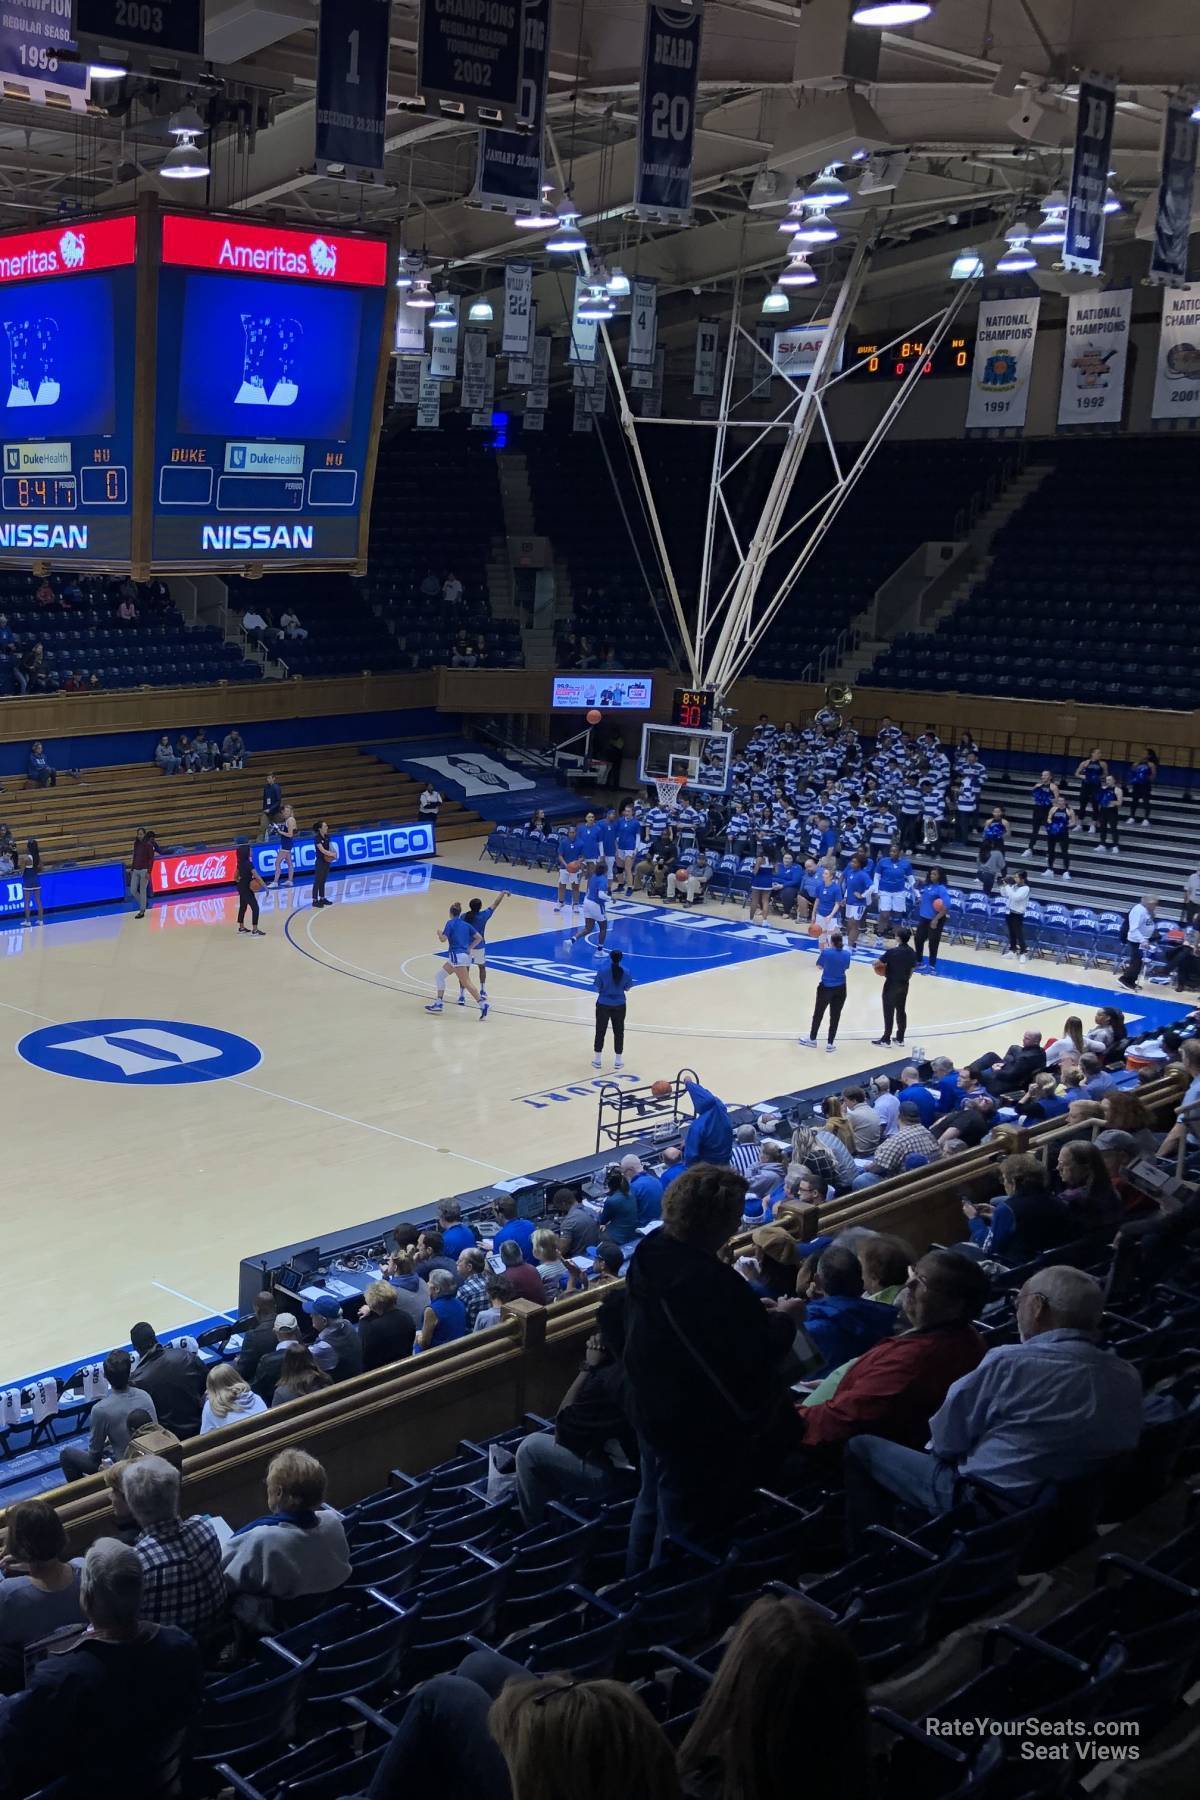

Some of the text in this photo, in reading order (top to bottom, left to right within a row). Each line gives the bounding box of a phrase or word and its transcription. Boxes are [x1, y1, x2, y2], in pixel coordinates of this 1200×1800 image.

[115, 1, 163, 33] 2003
[2, 14, 76, 43] REGULAR SEASO
[346, 29, 360, 84] 1
[653, 34, 694, 69] BEARD
[453, 58, 492, 87] 2002
[651, 92, 690, 141] 20
[219, 239, 309, 274] Ameritas
[986, 314, 1030, 327] NATIONAL
[1076, 306, 1122, 321] NATIONAL
[979, 328, 1033, 341] CHAMPIONS
[1069, 320, 1126, 336] CHAMPIONS
[857, 345, 878, 354] DUKE
[869, 358, 879, 372] 0
[956, 352, 967, 367] 0
[1077, 397, 1105, 408] 1992
[1171, 390, 1200, 402] 2001
[984, 402, 1010, 413] 1991
[23, 450, 68, 465] DukeHealth
[171, 448, 207, 463] DUKE
[250, 452, 301, 465] DukeHealth
[58, 480, 75, 489] PERIOD
[106, 470, 118, 500] 0
[285, 482, 303, 491] PERIOD
[202, 525, 313, 550] NISSAN
[680, 705, 701, 727] 30
[347, 830, 428, 860] GEICO
